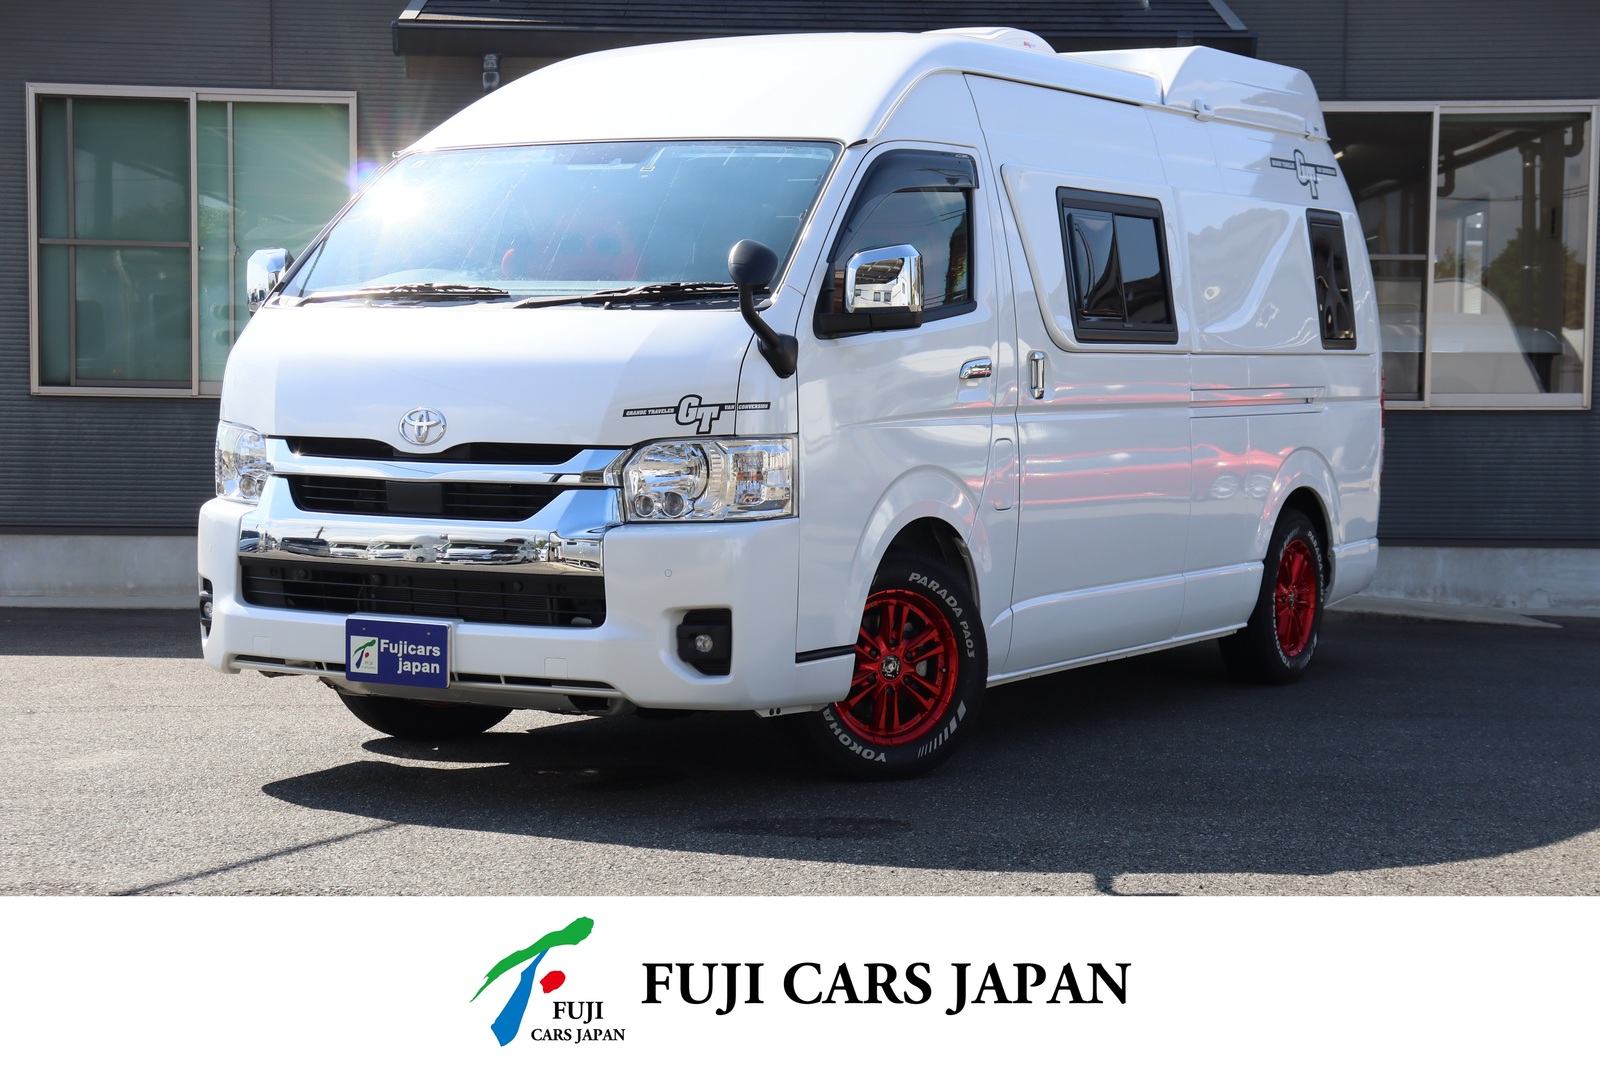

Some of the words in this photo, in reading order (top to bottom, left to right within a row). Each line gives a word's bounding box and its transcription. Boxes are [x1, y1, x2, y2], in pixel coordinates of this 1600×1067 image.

[626, 408, 647, 416] GRANDE
[647, 407, 675, 415] TRAVELER
[675, 394, 722, 434] GT
[908, 572, 963, 618] PARADA
[380, 639, 441, 657] Fujicars
[397, 658, 440, 675] japan
